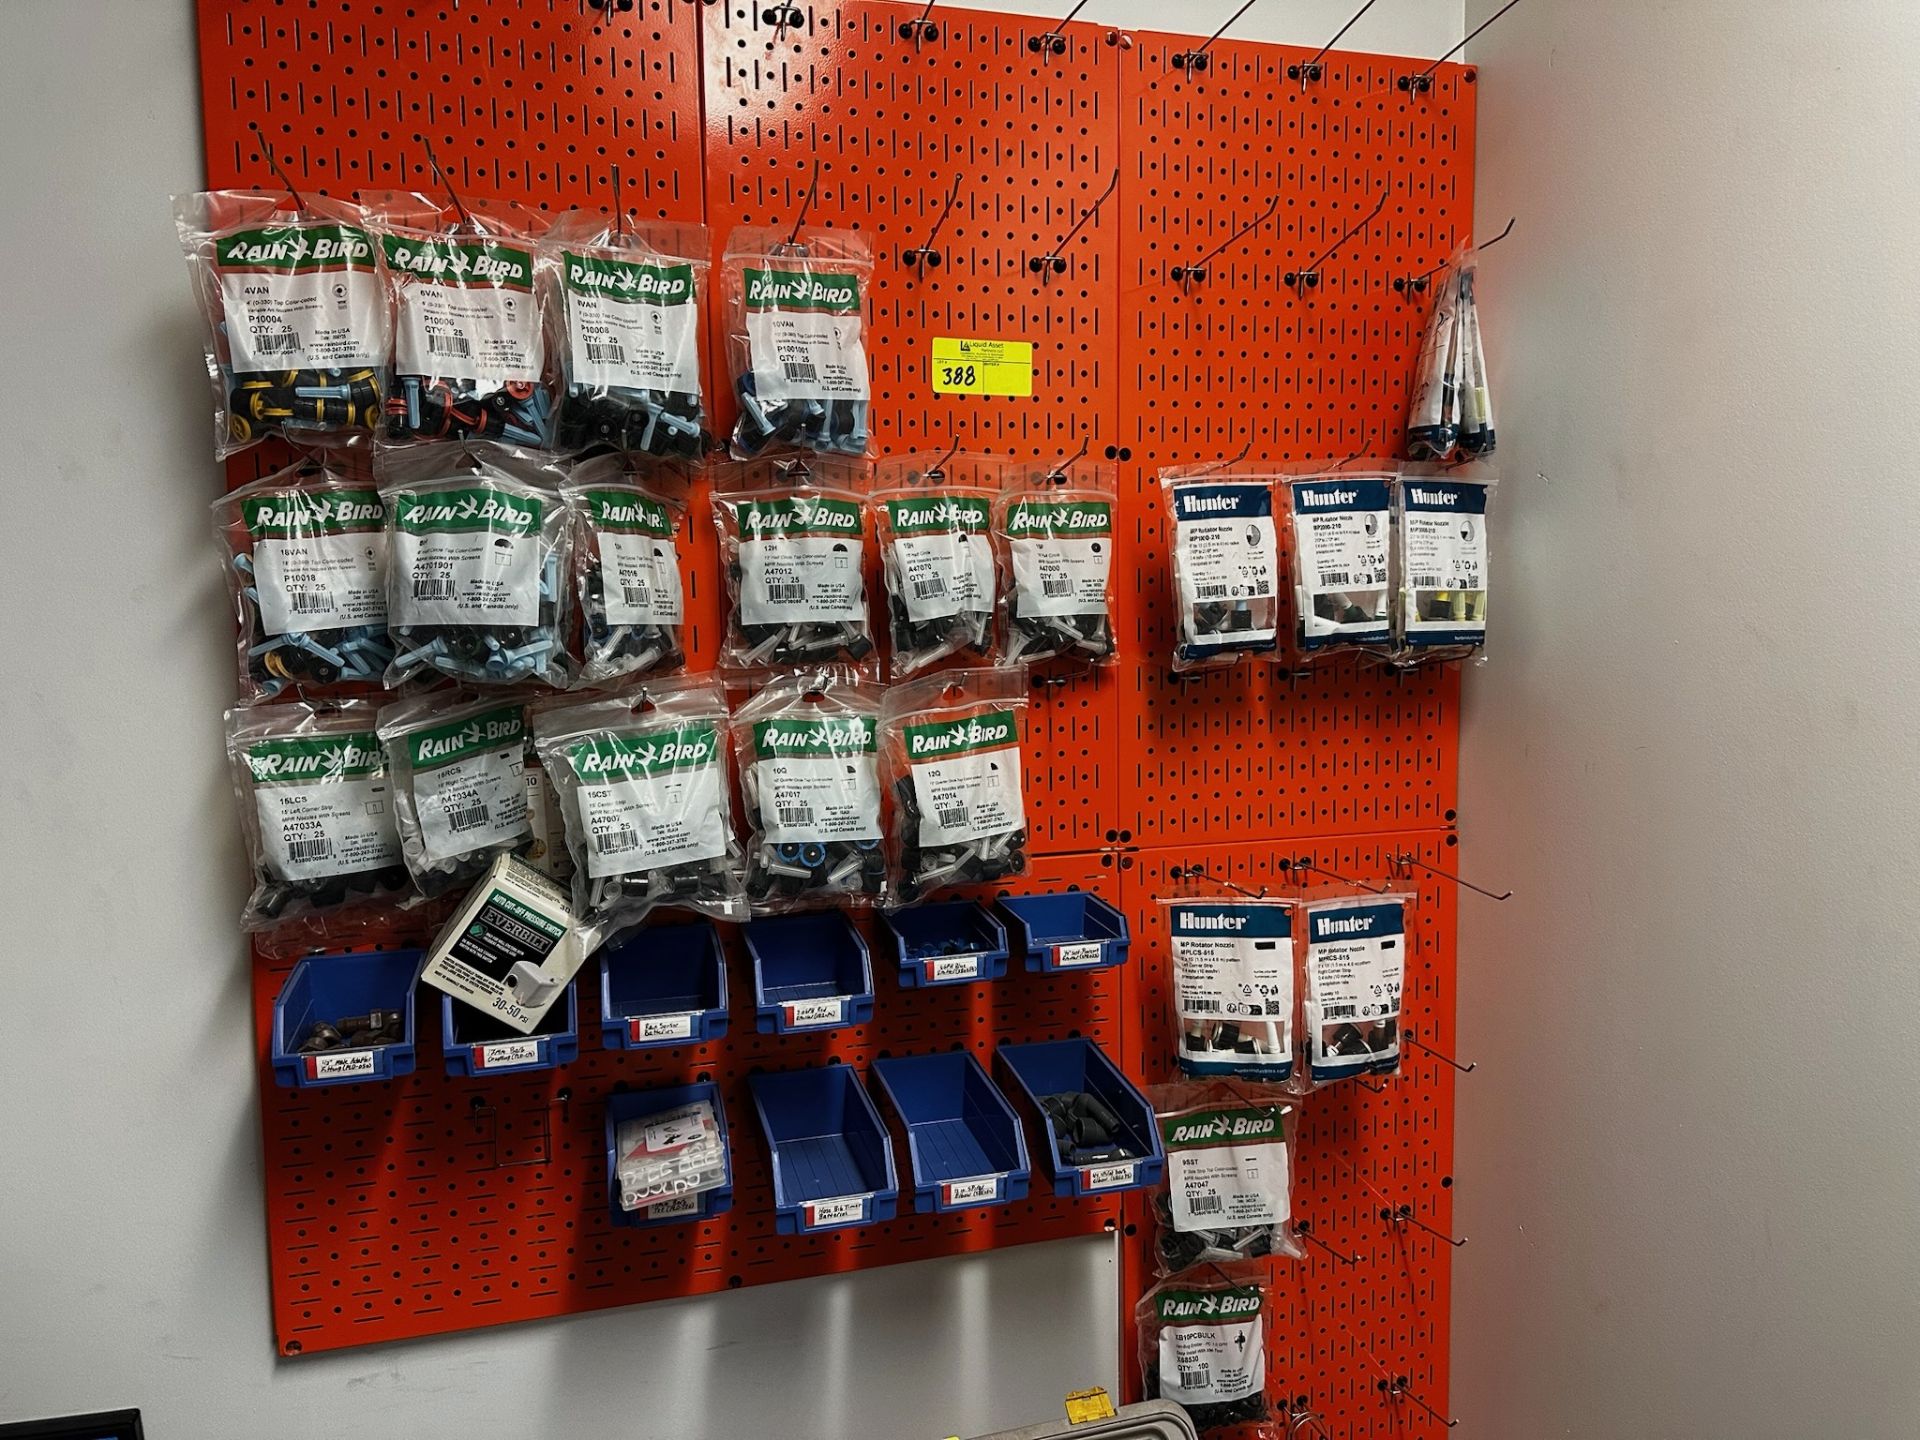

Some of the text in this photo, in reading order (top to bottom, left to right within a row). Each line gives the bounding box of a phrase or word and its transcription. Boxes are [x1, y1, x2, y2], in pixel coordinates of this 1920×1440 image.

[226, 238, 368, 260] RAIN BIRD
[393, 246, 523, 279] RAIN BIRD
[570, 264, 685, 295] RAIN BIRD
[244, 286, 270, 295] 4VAN
[749, 280, 852, 304] RAIN BIRD
[248, 315, 283, 324] P10004
[250, 325, 293, 334] QTY: 25
[424, 326, 464, 337] QTY: 25
[582, 334, 619, 344] QTY: 25
[779, 354, 810, 363] QTY: 25
[942, 365, 976, 387] 388
[1183, 493, 1240, 513] Hunter
[1301, 488, 1358, 507] Hunter
[1410, 488, 1458, 506] Hunter
[256, 501, 383, 527] RAIN BIRD
[403, 498, 533, 526] RAIN BIRD
[601, 500, 635, 522] RAIN
[745, 507, 856, 531] RAIN BIRD
[897, 508, 935, 527] RAIN
[1011, 510, 1108, 531] RAIN BIRD
[284, 574, 316, 583] P10018
[439, 571, 451, 579] 25
[764, 568, 793, 576] A47012
[765, 576, 800, 585] QTY: 25
[931, 571, 939, 579] 25
[285, 583, 326, 592] QTY: 25
[637, 579, 645, 587] 25
[418, 719, 521, 761] RAIN BIRD
[762, 728, 872, 748] RAIN BIRD
[912, 724, 1008, 754] RAIN BIRD
[261, 753, 322, 776] RAIN
[582, 742, 708, 773] RAIN BIRD
[928, 770, 941, 778] 12Q
[774, 791, 801, 799] A47017
[932, 792, 957, 802] A47014
[956, 800, 964, 808] 25
[443, 798, 482, 813] QTY: 25
[283, 821, 323, 832] A47033A
[620, 822, 631, 831] 25
[283, 833, 307, 842] QTY:
[492, 893, 563, 938] AUTO CUT-OFF PRESSURE SWITCH
[1179, 911, 1248, 931] Hunter
[484, 908, 548, 951] EVERBILT
[1317, 915, 1374, 936] Hunter
[492, 997, 529, 1024] 30-50 PSI
[1171, 1117, 1275, 1142] RAIN BIRD
[1184, 1181, 1209, 1189] A47047
[1185, 1190, 1203, 1198] QTY:
[1162, 1296, 1261, 1317] RAIN BIRD
[1177, 1362, 1209, 1372] QTY: 100
